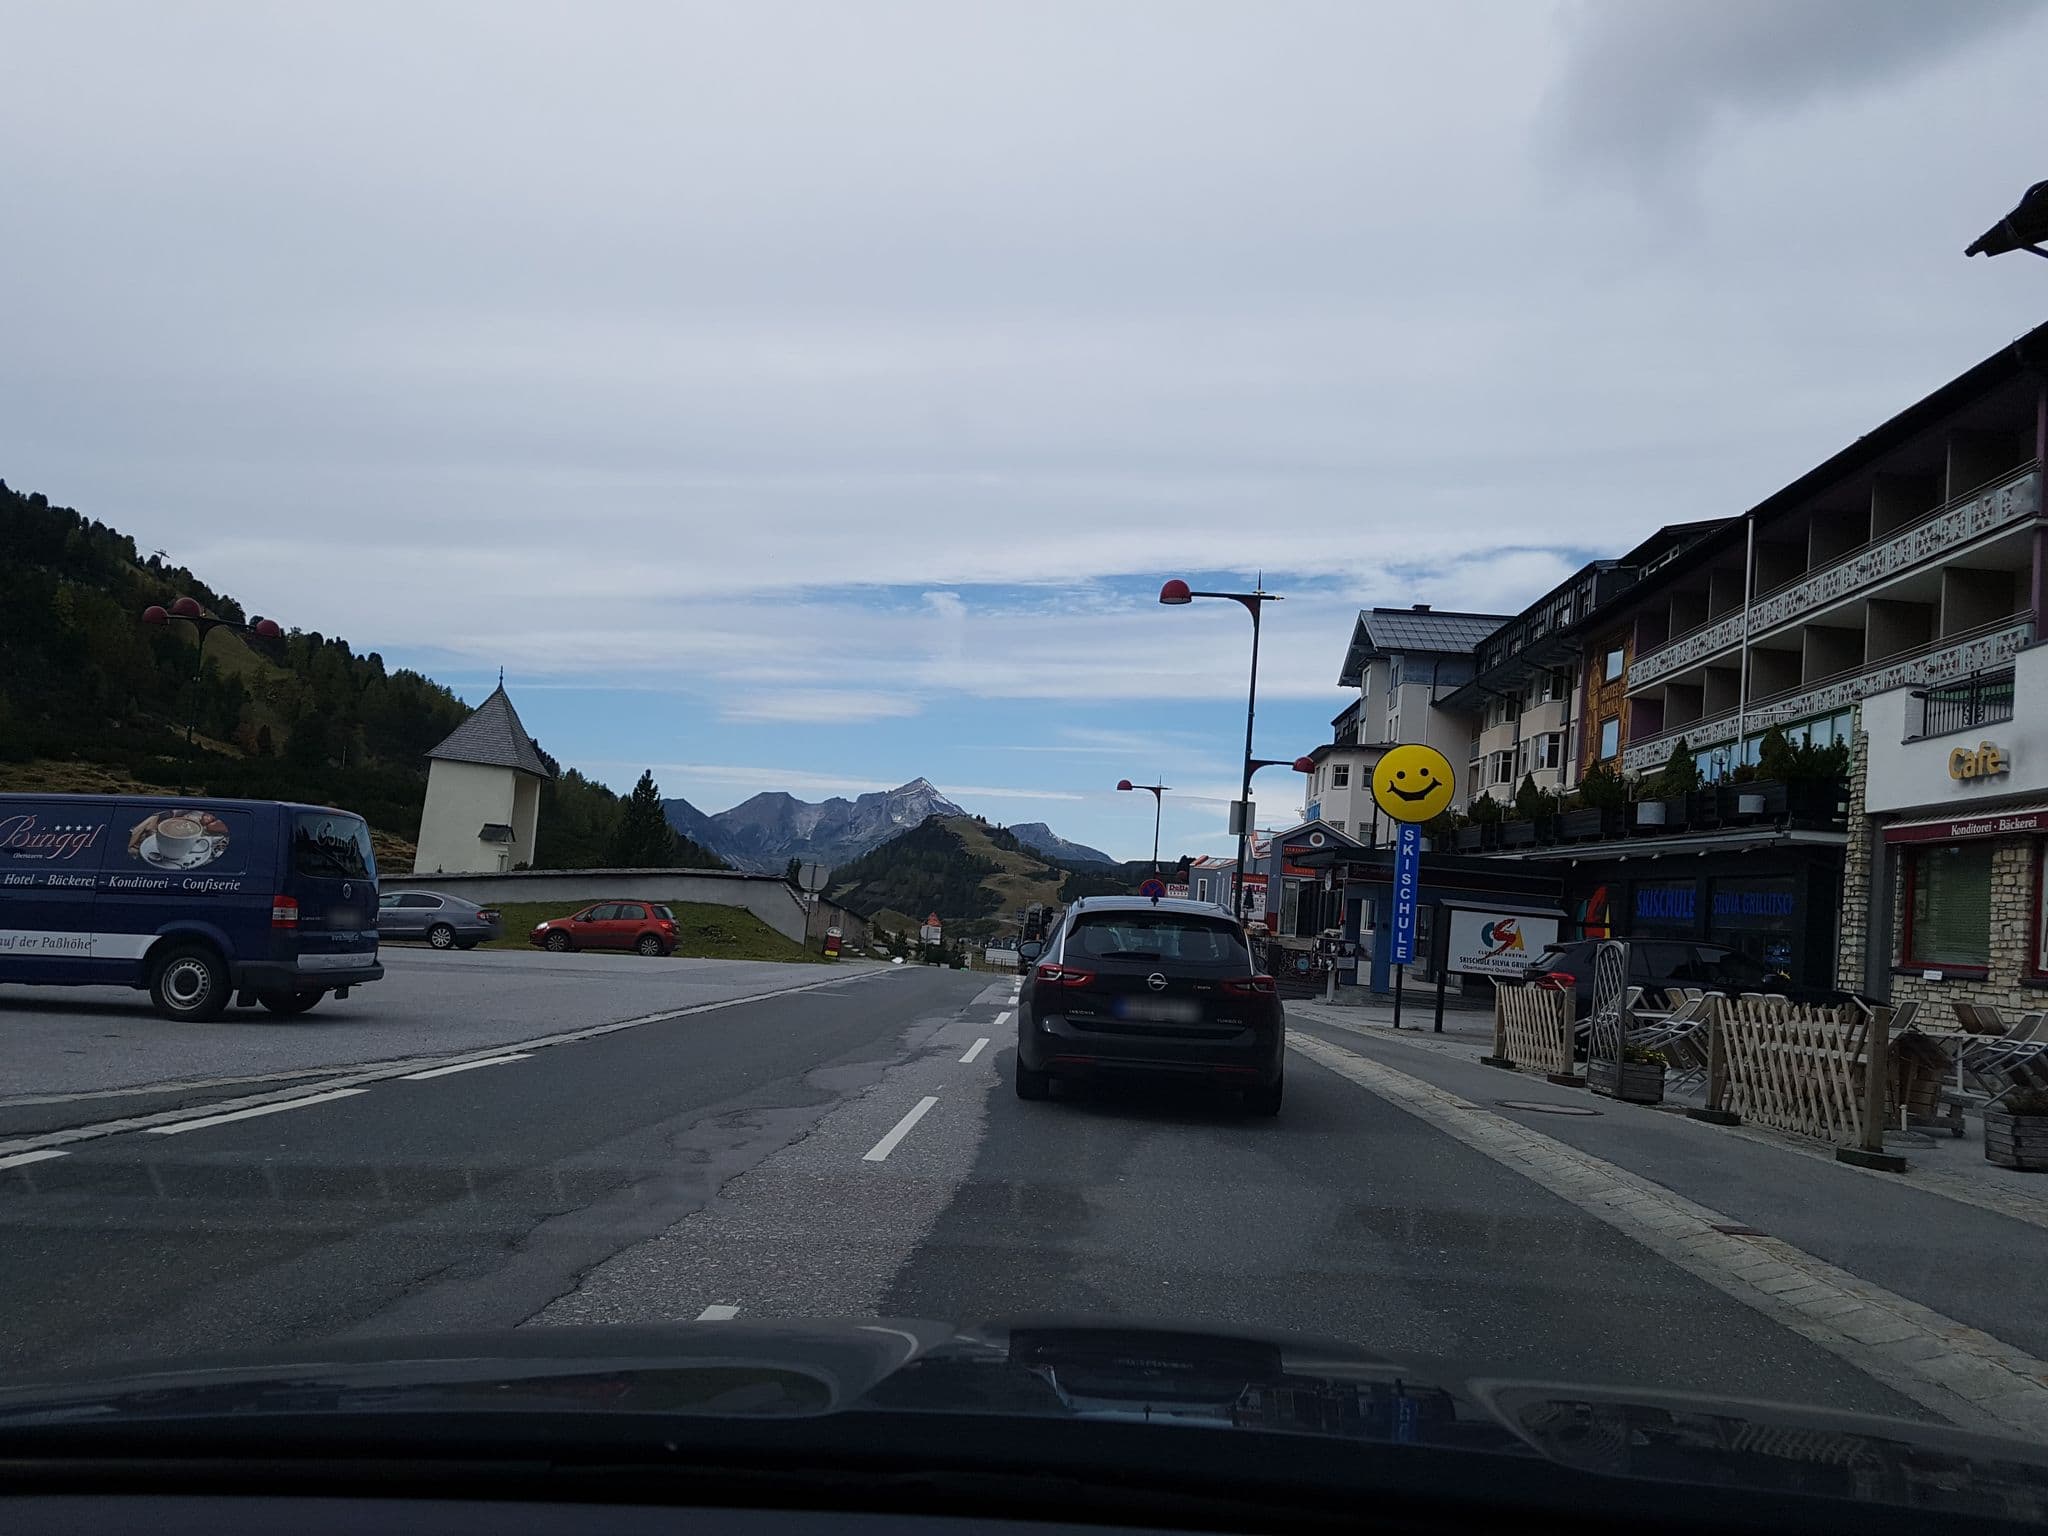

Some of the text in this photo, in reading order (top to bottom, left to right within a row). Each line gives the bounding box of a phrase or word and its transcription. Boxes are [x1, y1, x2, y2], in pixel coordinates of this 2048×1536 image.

[1951, 816, 2037, 836] Konditorei Bäckerei
[0, 815, 106, 860] Binggl
[4, 873, 241, 893] Hotel Bäckerei Konditorei Confiserie
[1397, 829, 1414, 959] SKISCHULE
[20, 936, 38, 948] der
